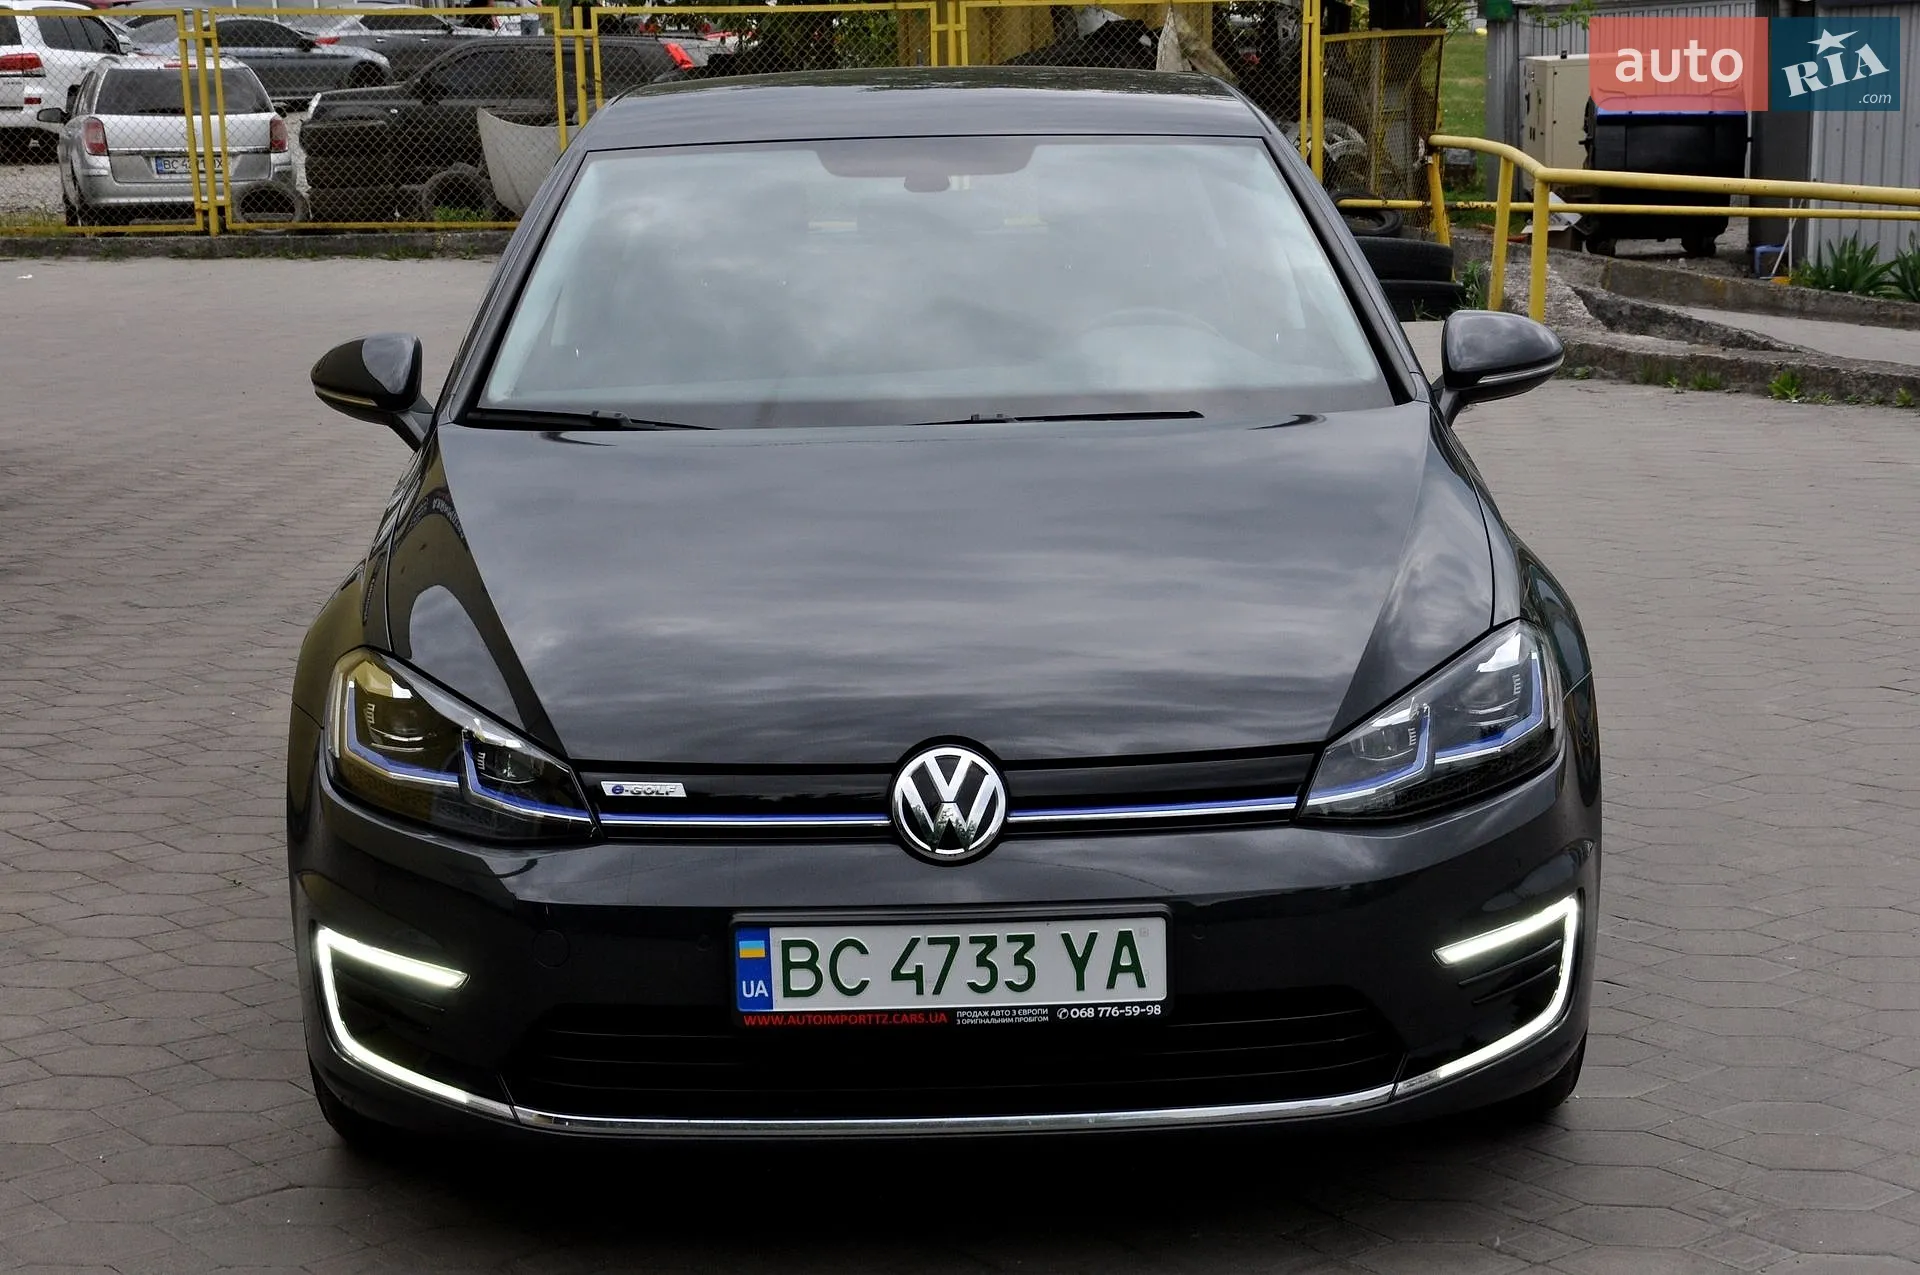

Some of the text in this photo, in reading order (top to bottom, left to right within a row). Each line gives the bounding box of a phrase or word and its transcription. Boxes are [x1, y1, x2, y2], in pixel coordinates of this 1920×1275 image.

[780, 929, 1147, 998] BC 4733 YA
[742, 980, 769, 998] UA
[956, 1010, 989, 1018] ПРОДАЖ
[990, 1009, 1011, 1017] АВТО
[1017, 1008, 1049, 1016] ЄВРОПИ
[1070, 1004, 1161, 1018] 068 776-59-98
[743, 1012, 948, 1026] WWW.AUTOIMPORTTZ.CARS.UA
